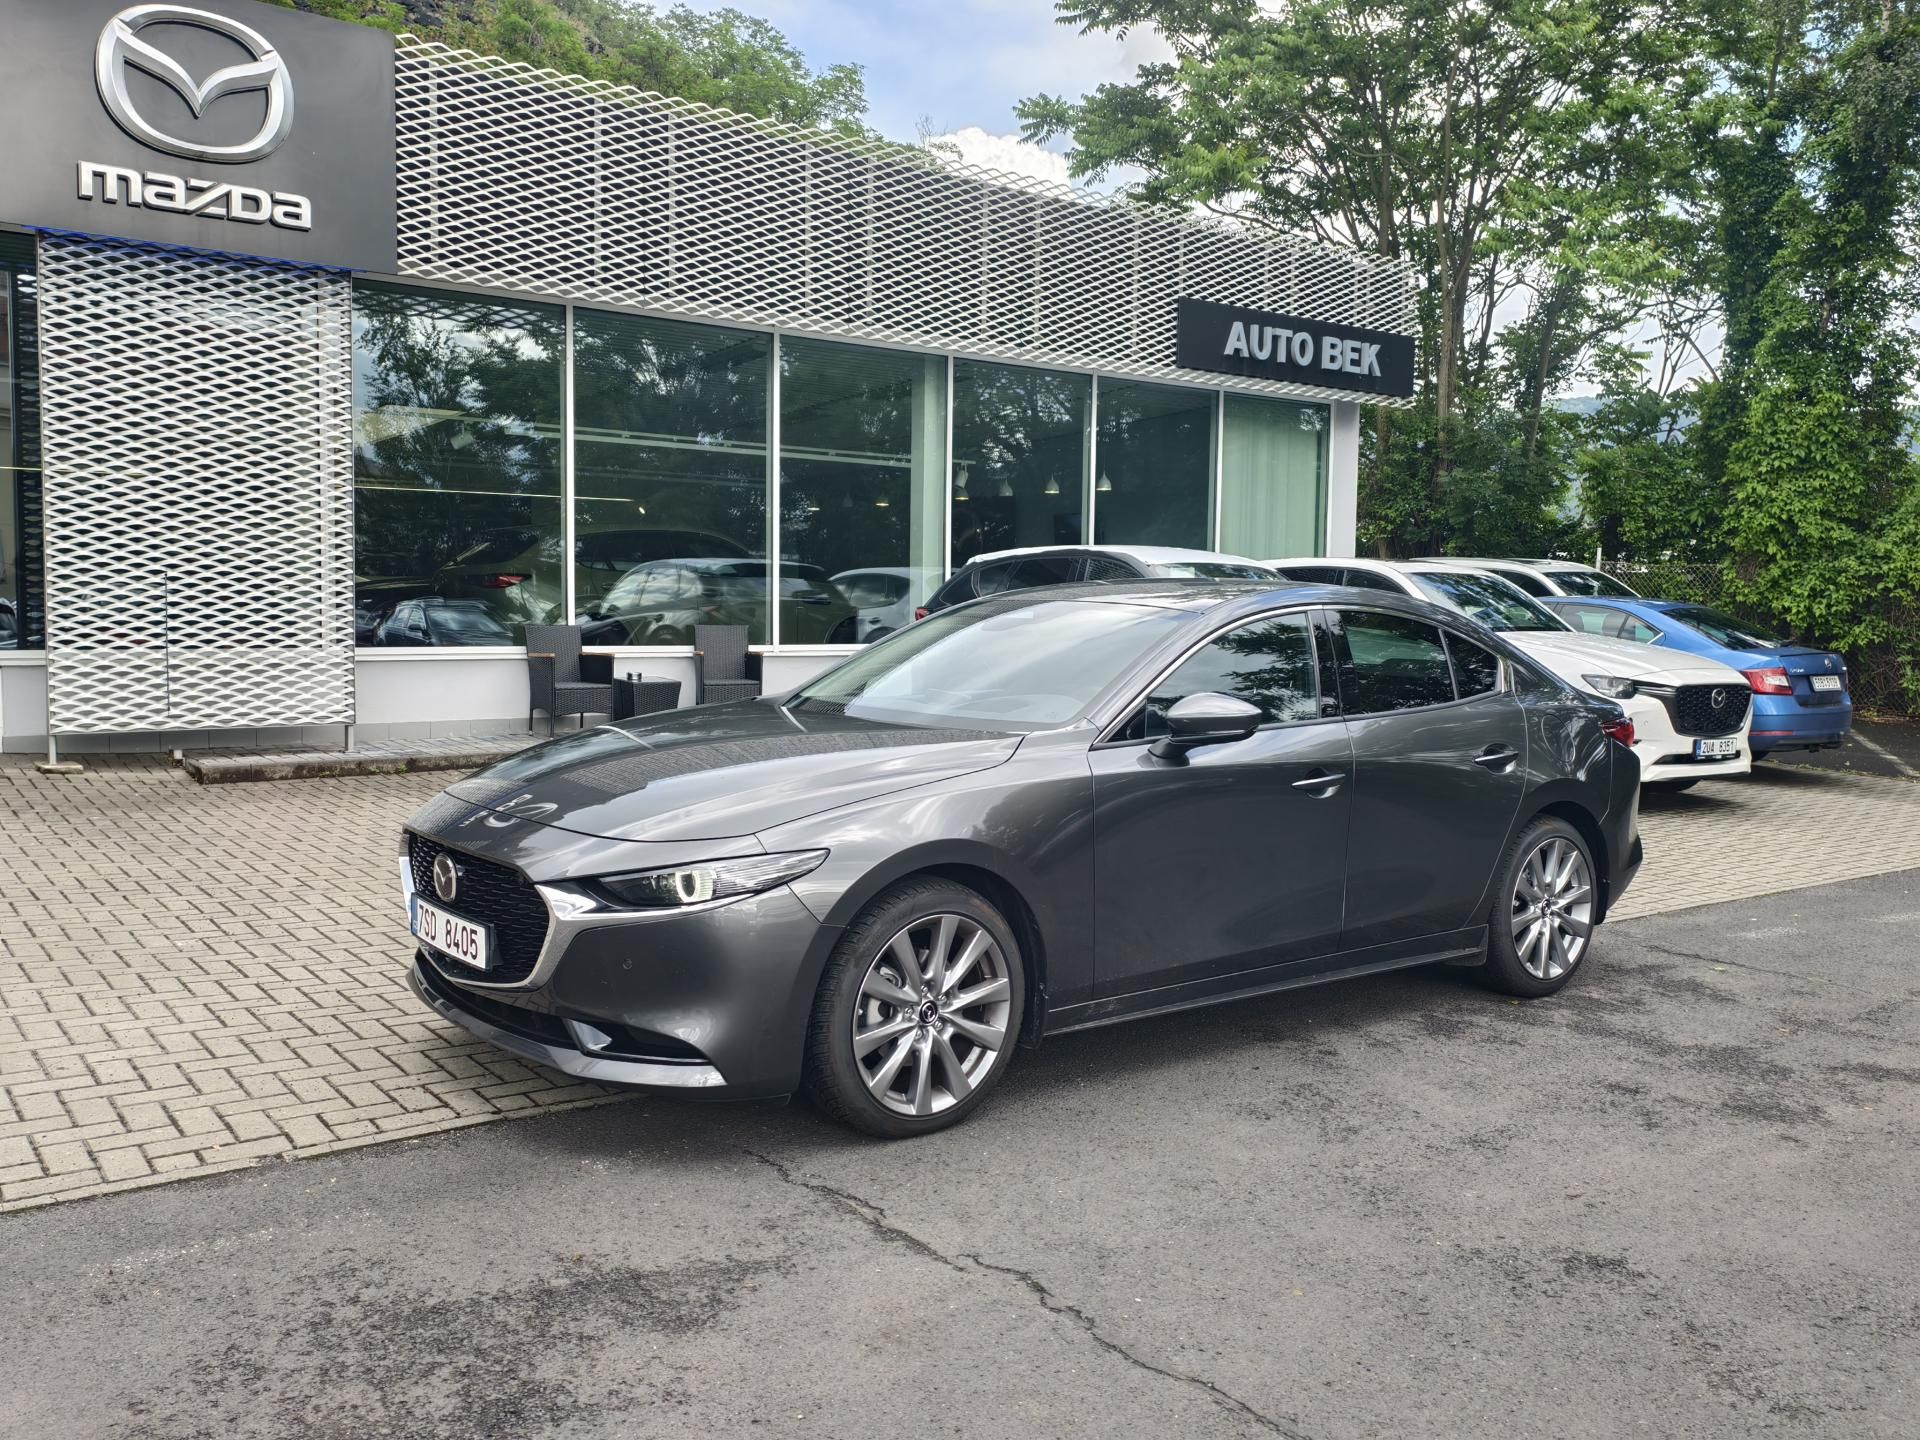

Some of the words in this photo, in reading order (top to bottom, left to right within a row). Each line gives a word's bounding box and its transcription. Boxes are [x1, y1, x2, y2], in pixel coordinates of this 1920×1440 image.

[78, 160, 312, 232] mazda
[1223, 321, 1314, 367] AUTO
[1321, 336, 1382, 377] BEK
[1702, 741, 1715, 754] 2UA
[419, 903, 437, 941] 7SD
[445, 918, 478, 960] 8405
